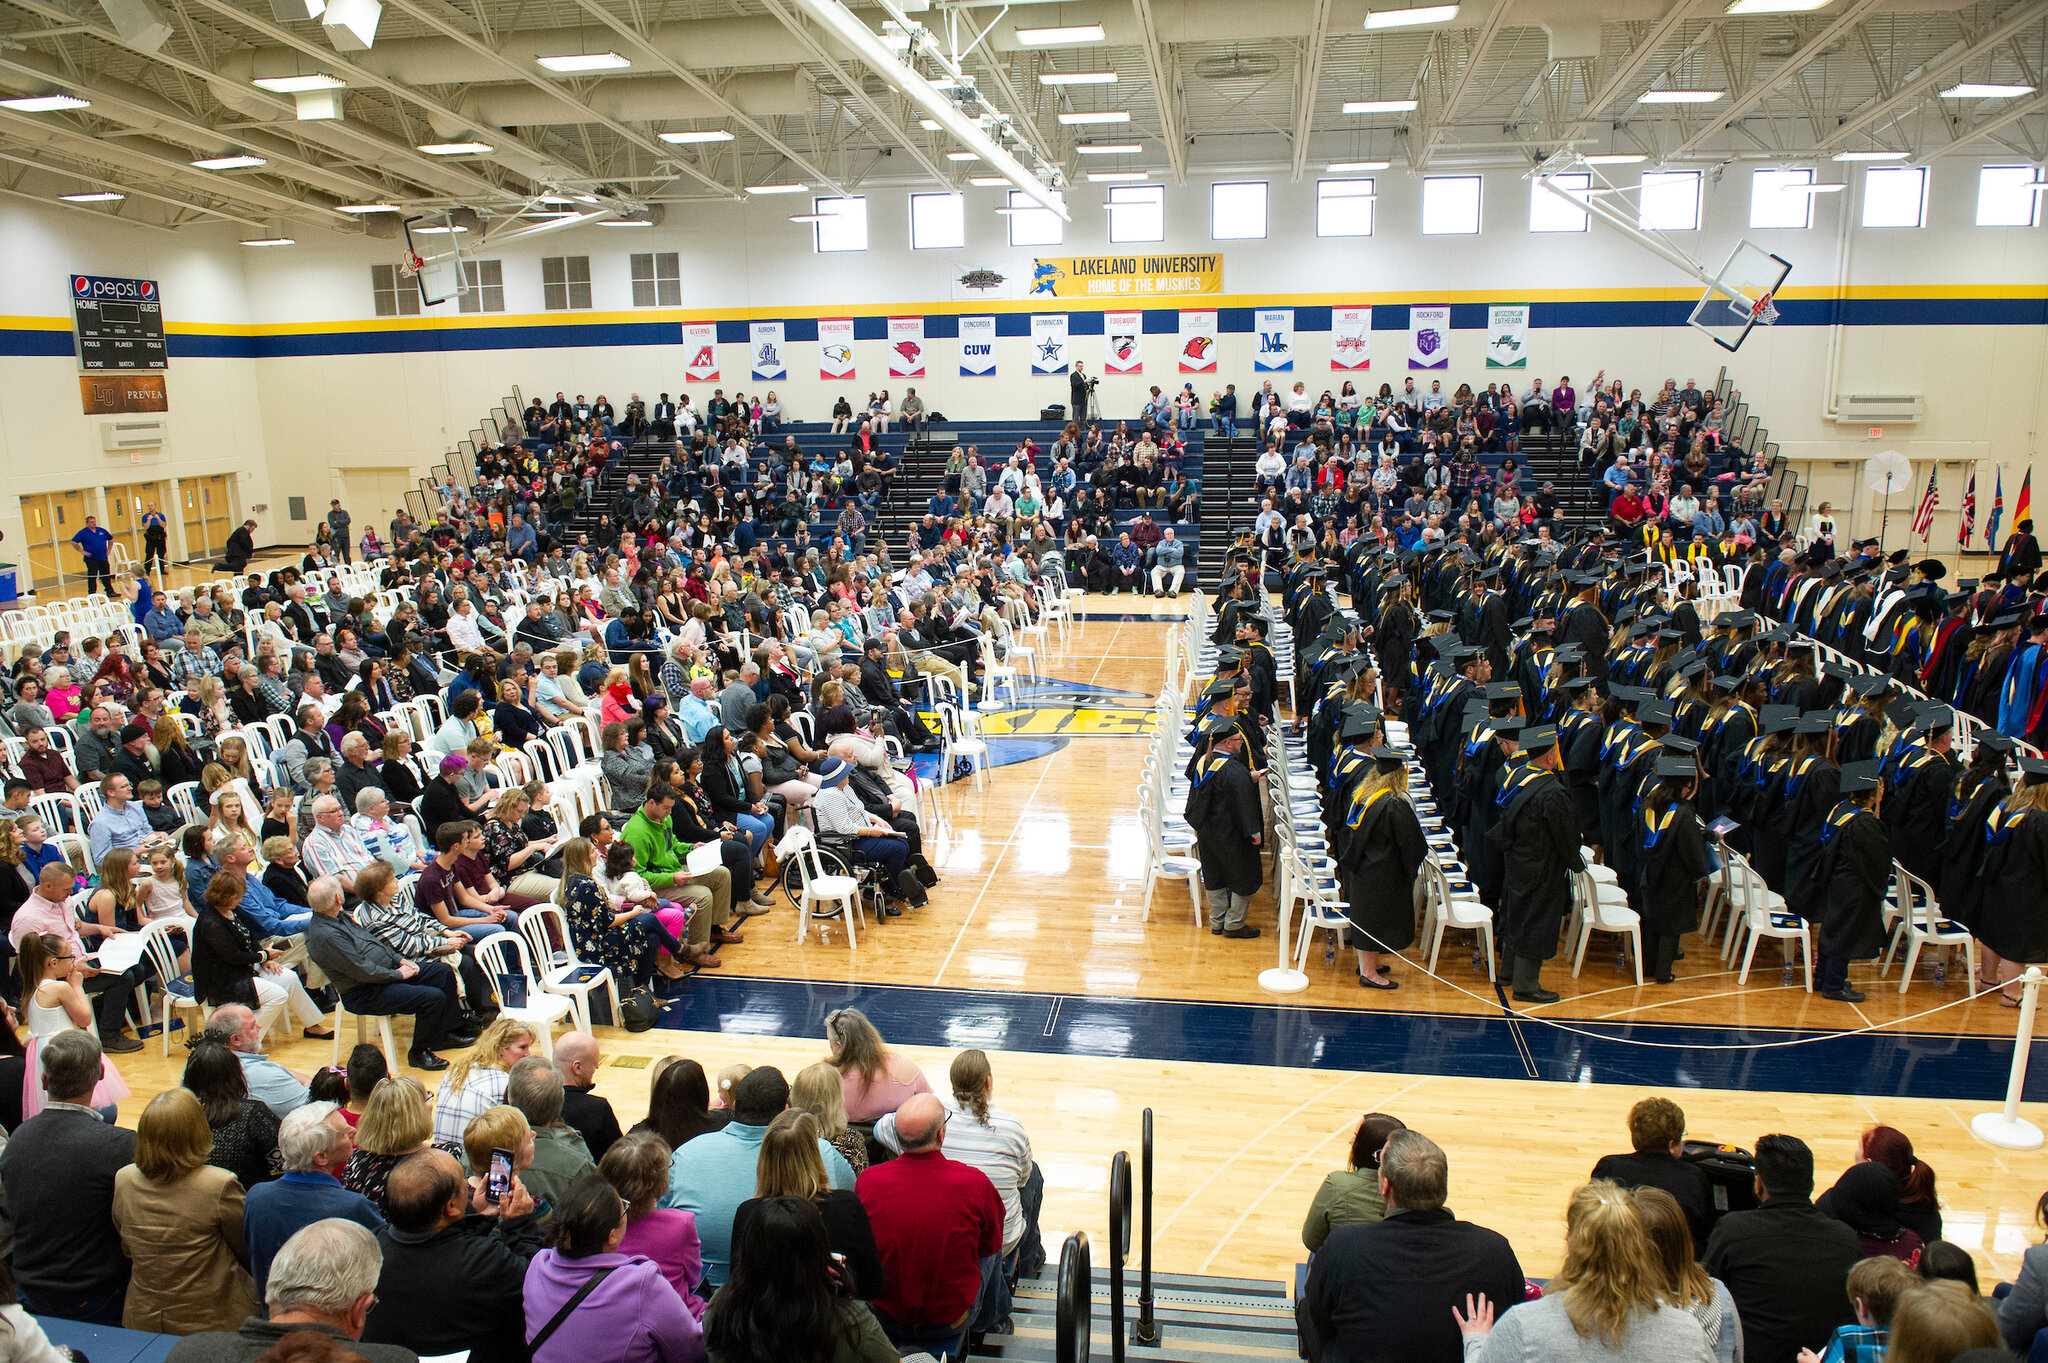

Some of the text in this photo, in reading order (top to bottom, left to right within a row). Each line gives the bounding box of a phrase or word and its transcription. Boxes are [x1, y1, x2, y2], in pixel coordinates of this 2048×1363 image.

[1073, 256, 1216, 275] LAKELAND UNIVERSITY
[93, 281, 138, 299] pepsi
[1088, 277, 1201, 293] HOME OF THE MUSKIES
[76, 300, 98, 310] HOME
[140, 303, 160, 313] GUEST
[1416, 311, 1444, 319] ROCKFORD
[893, 322, 920, 330] CONCORDIA
[963, 320, 991, 328] CONCORDIA
[1110, 317, 1137, 325] EDGEWOOD
[964, 345, 991, 355] CUW
[127, 390, 163, 400] PREVEA
